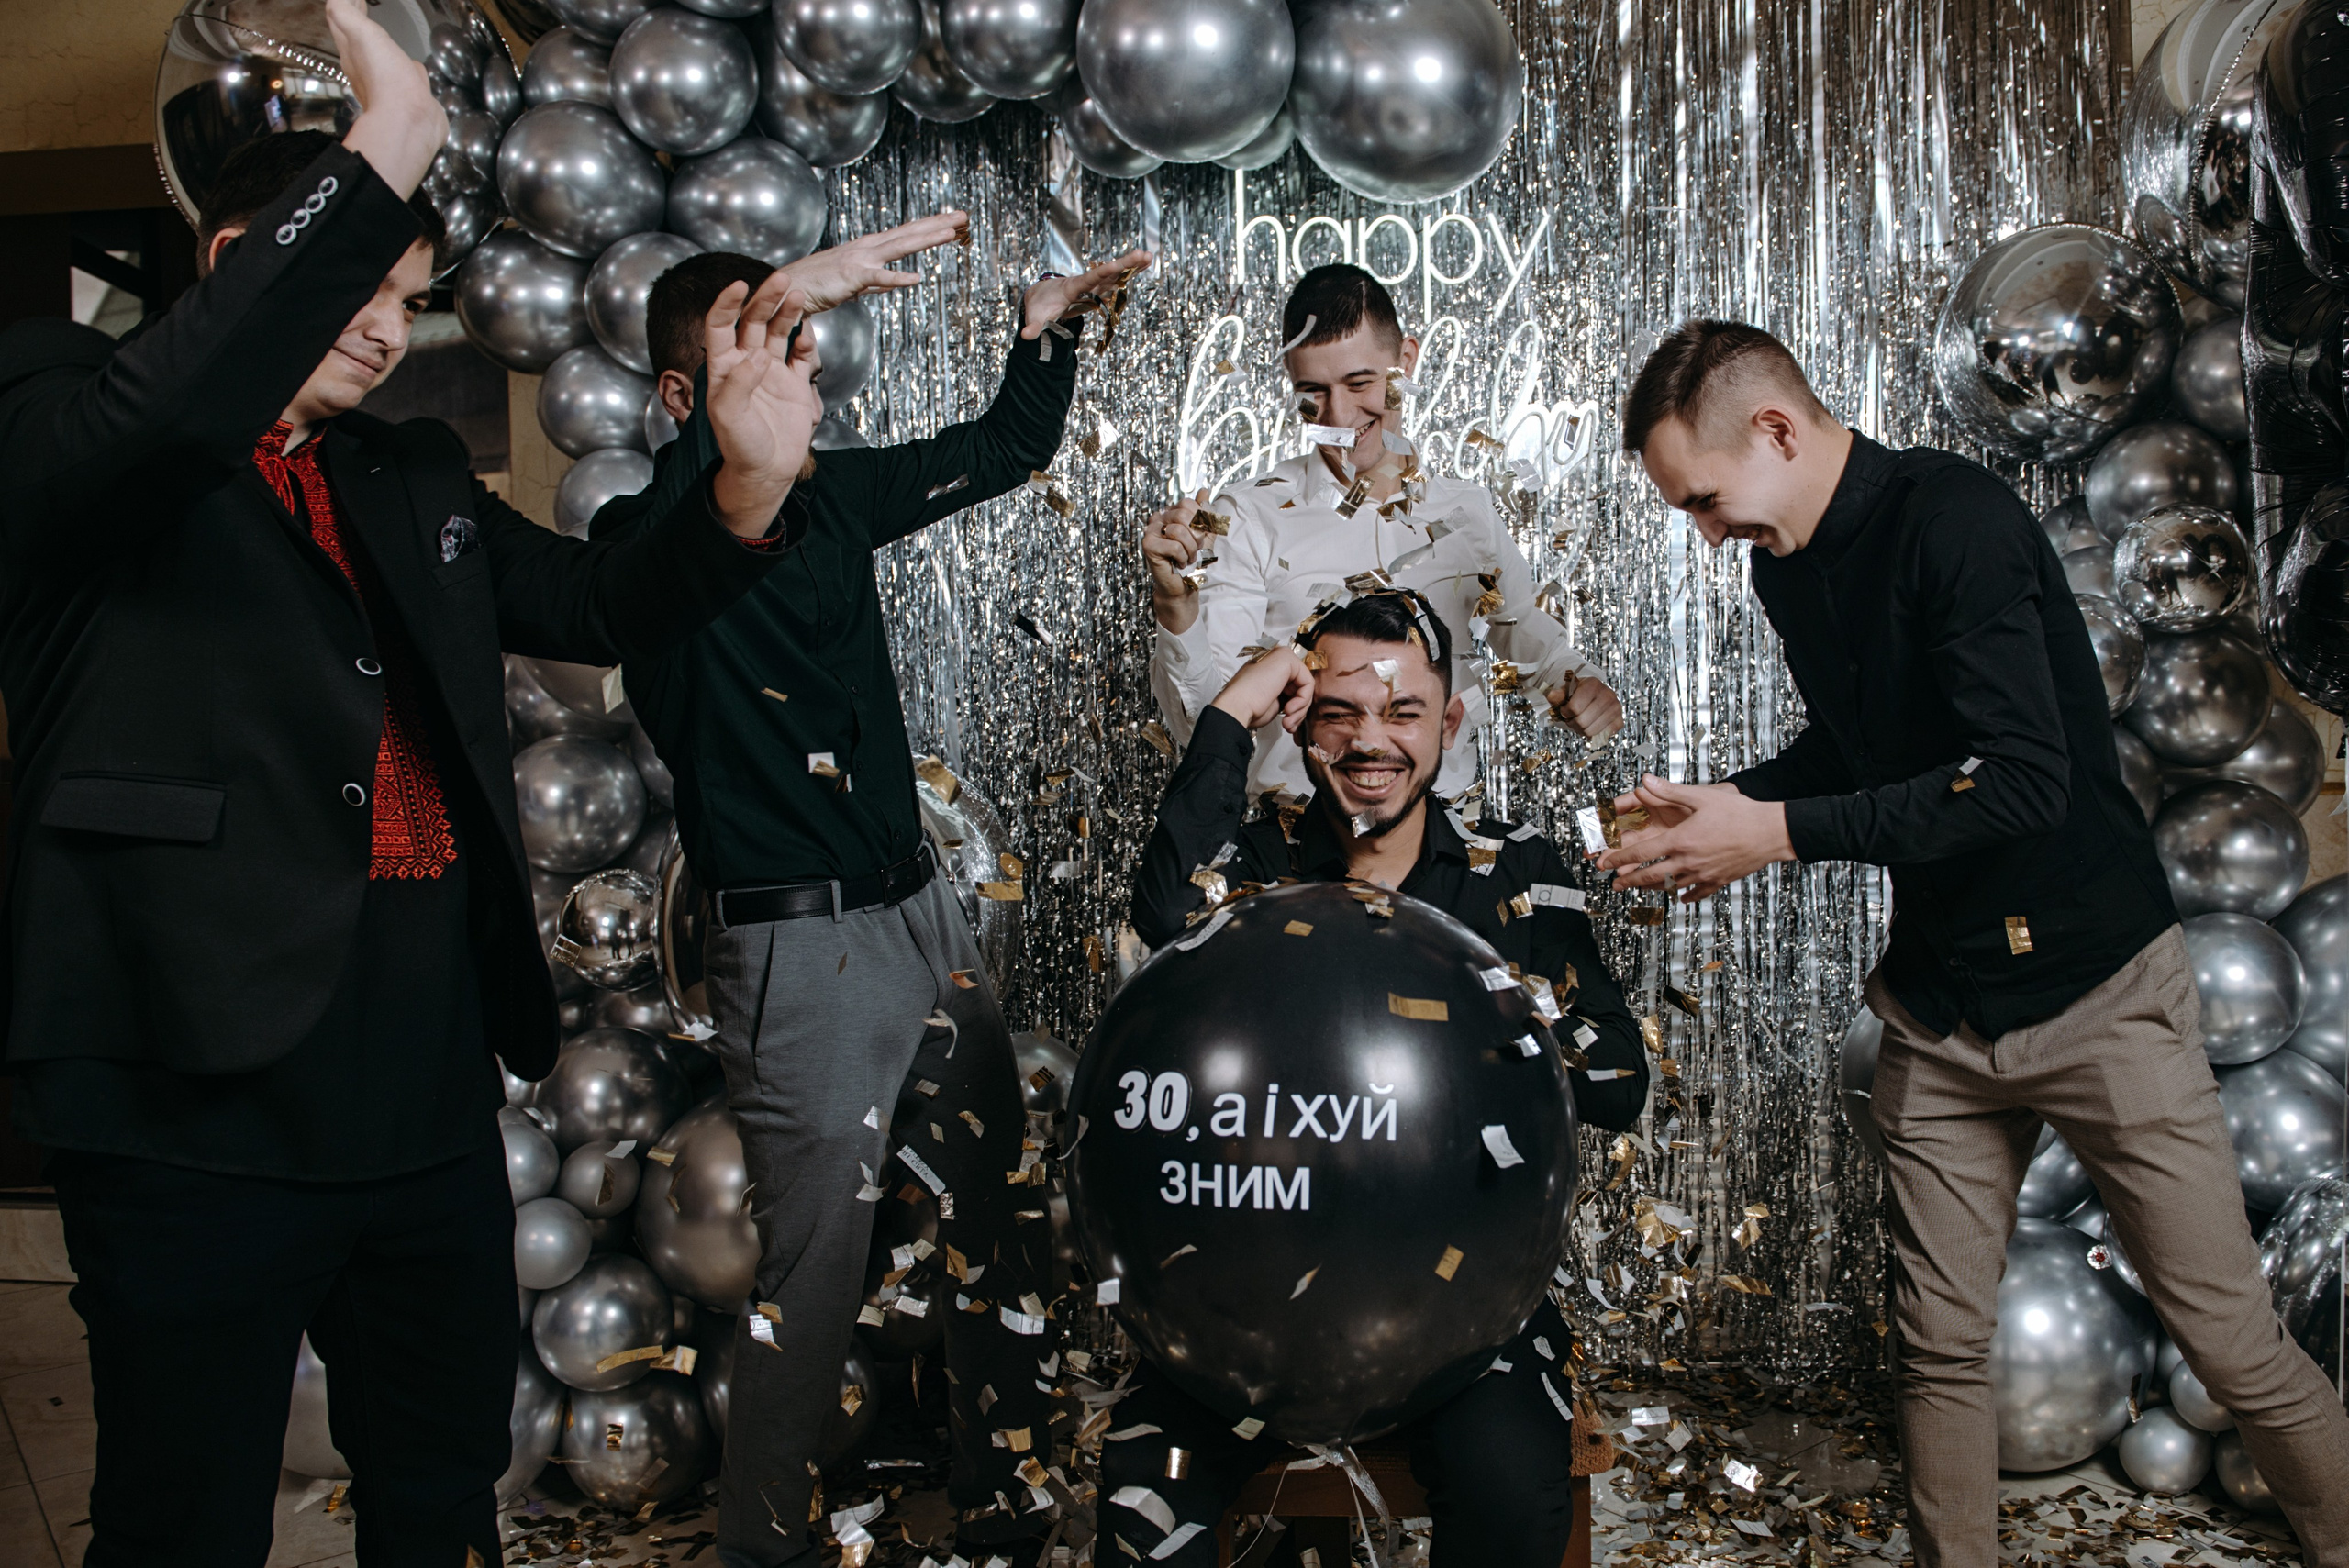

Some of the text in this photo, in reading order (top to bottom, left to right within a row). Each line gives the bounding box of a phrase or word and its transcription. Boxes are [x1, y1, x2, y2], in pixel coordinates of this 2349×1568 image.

[1234, 169, 1551, 324] happy
[1113, 1069, 1398, 1143] 30, а і хуй
